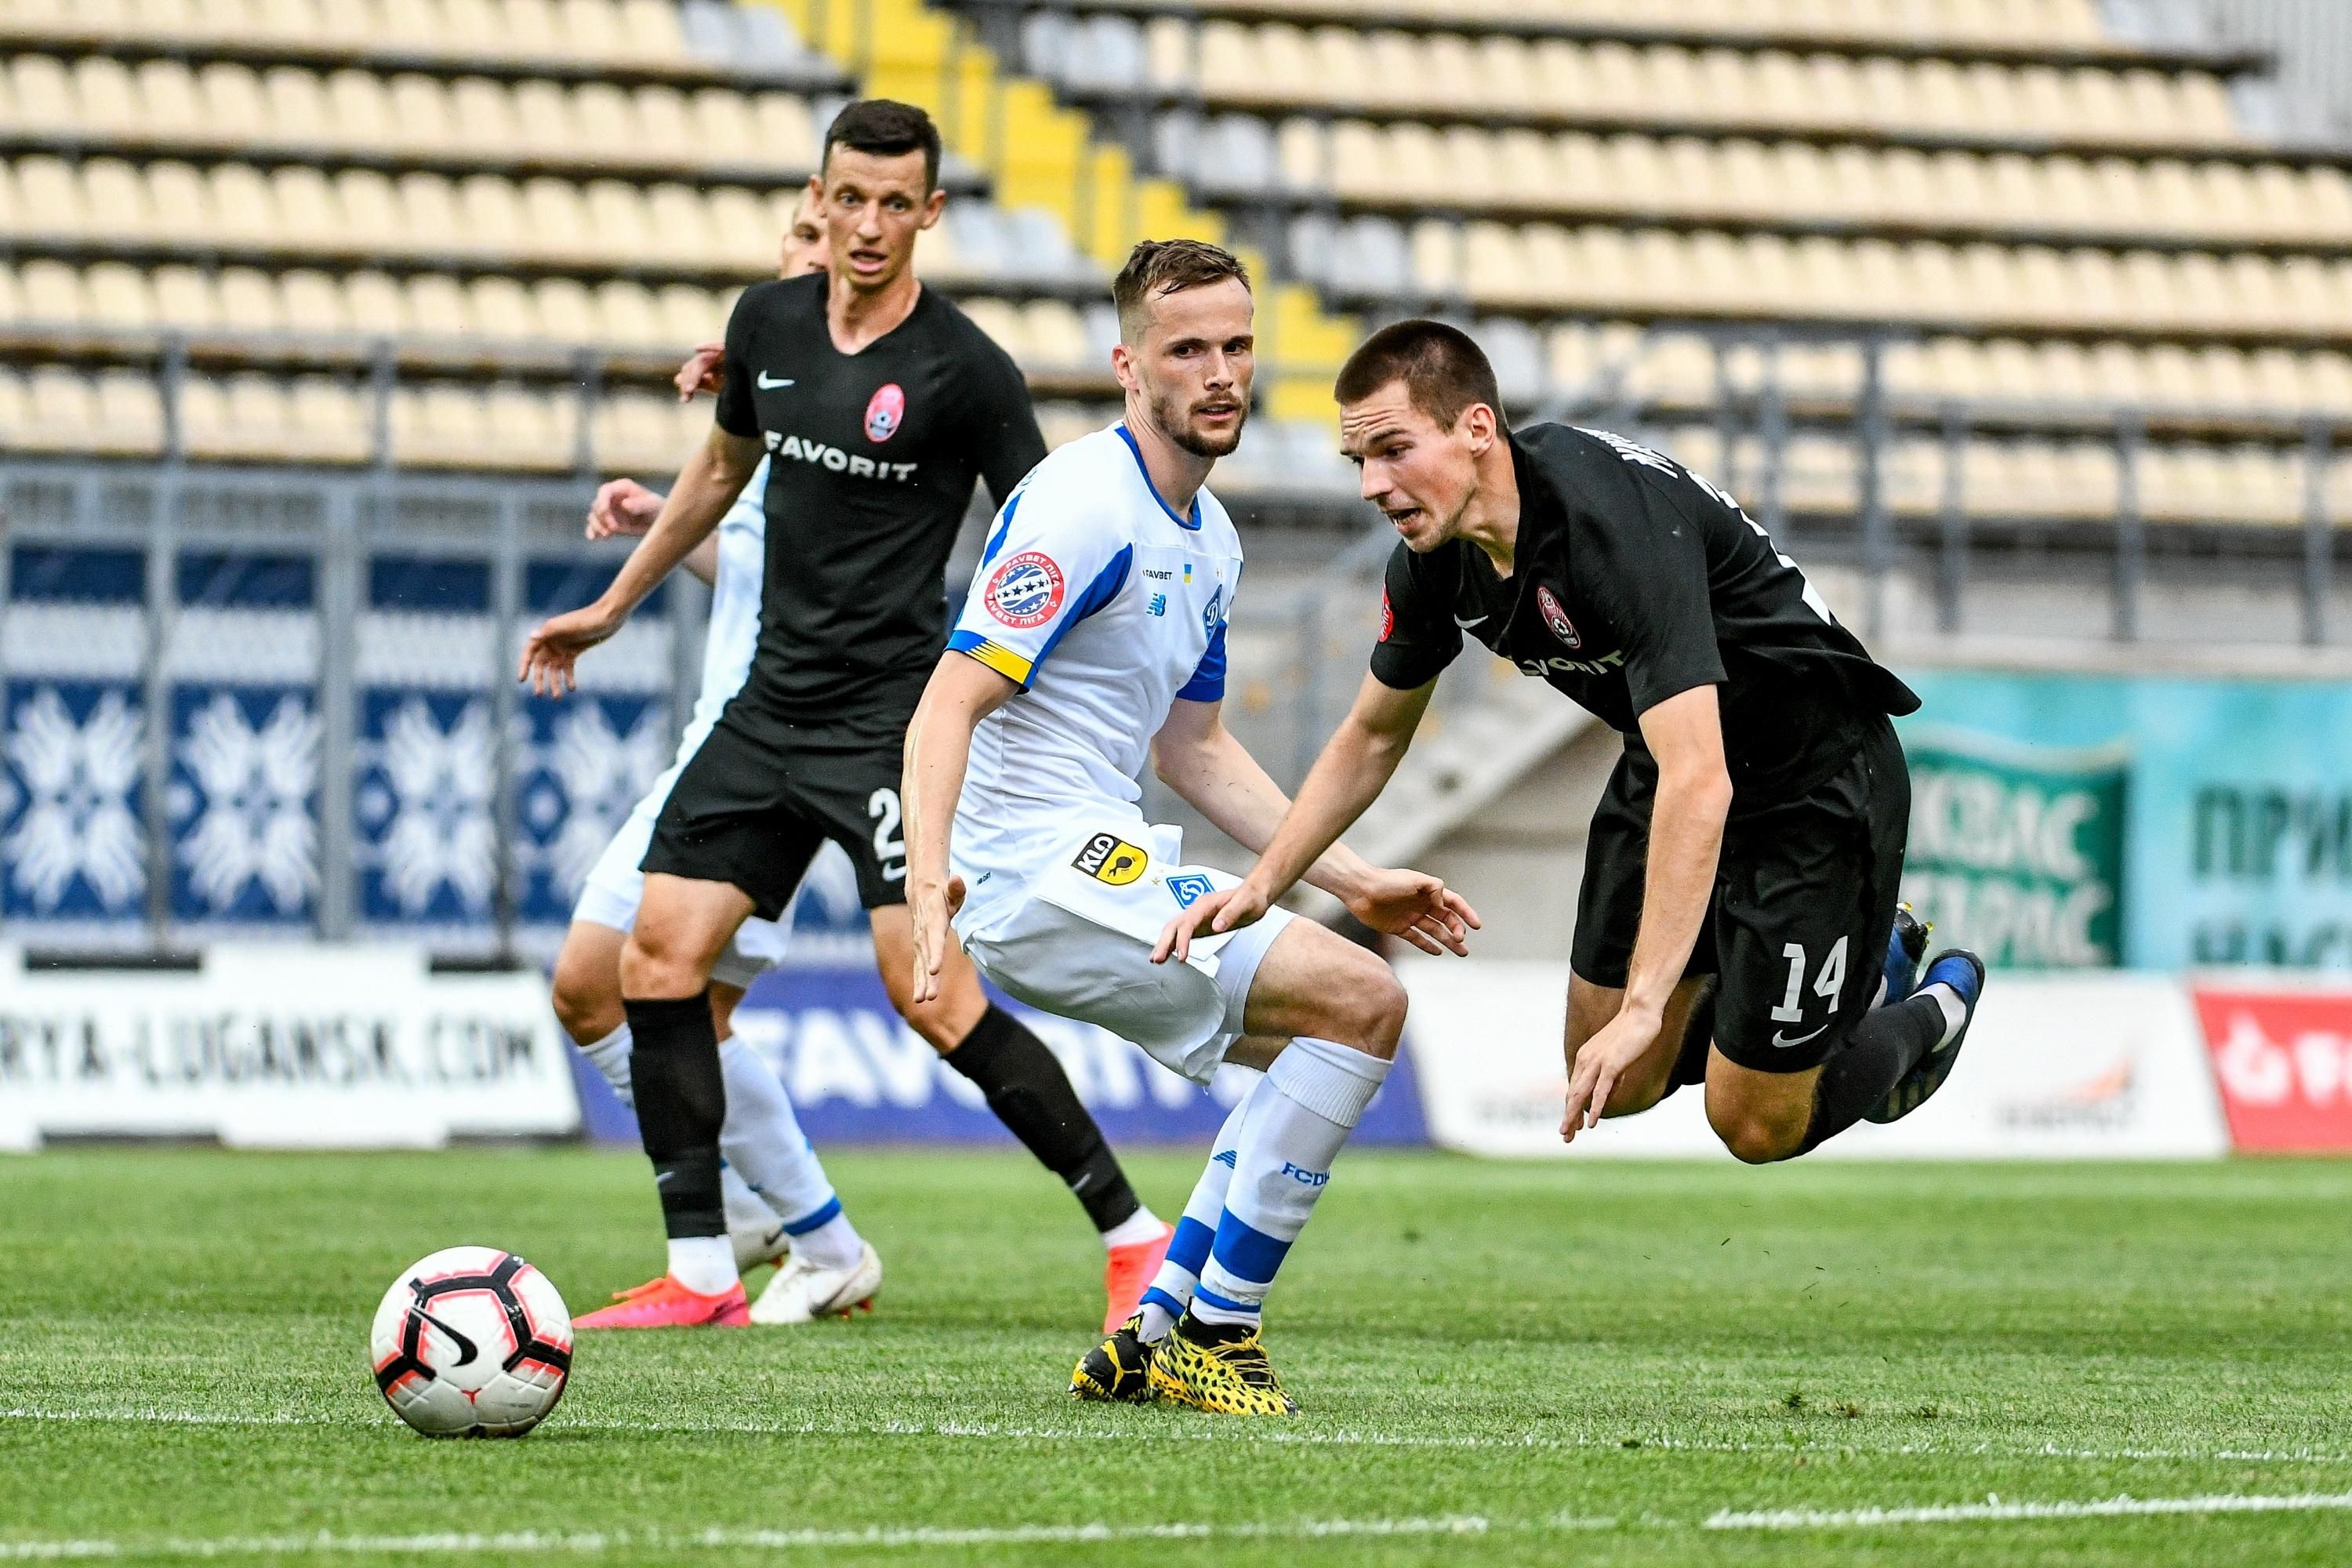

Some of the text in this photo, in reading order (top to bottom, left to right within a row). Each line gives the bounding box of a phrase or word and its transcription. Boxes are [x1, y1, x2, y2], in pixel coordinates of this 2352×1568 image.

[764, 430, 918, 482] FAVORIT
[1076, 836, 1115, 874] KLO
[1770, 935, 1849, 1023] 14
